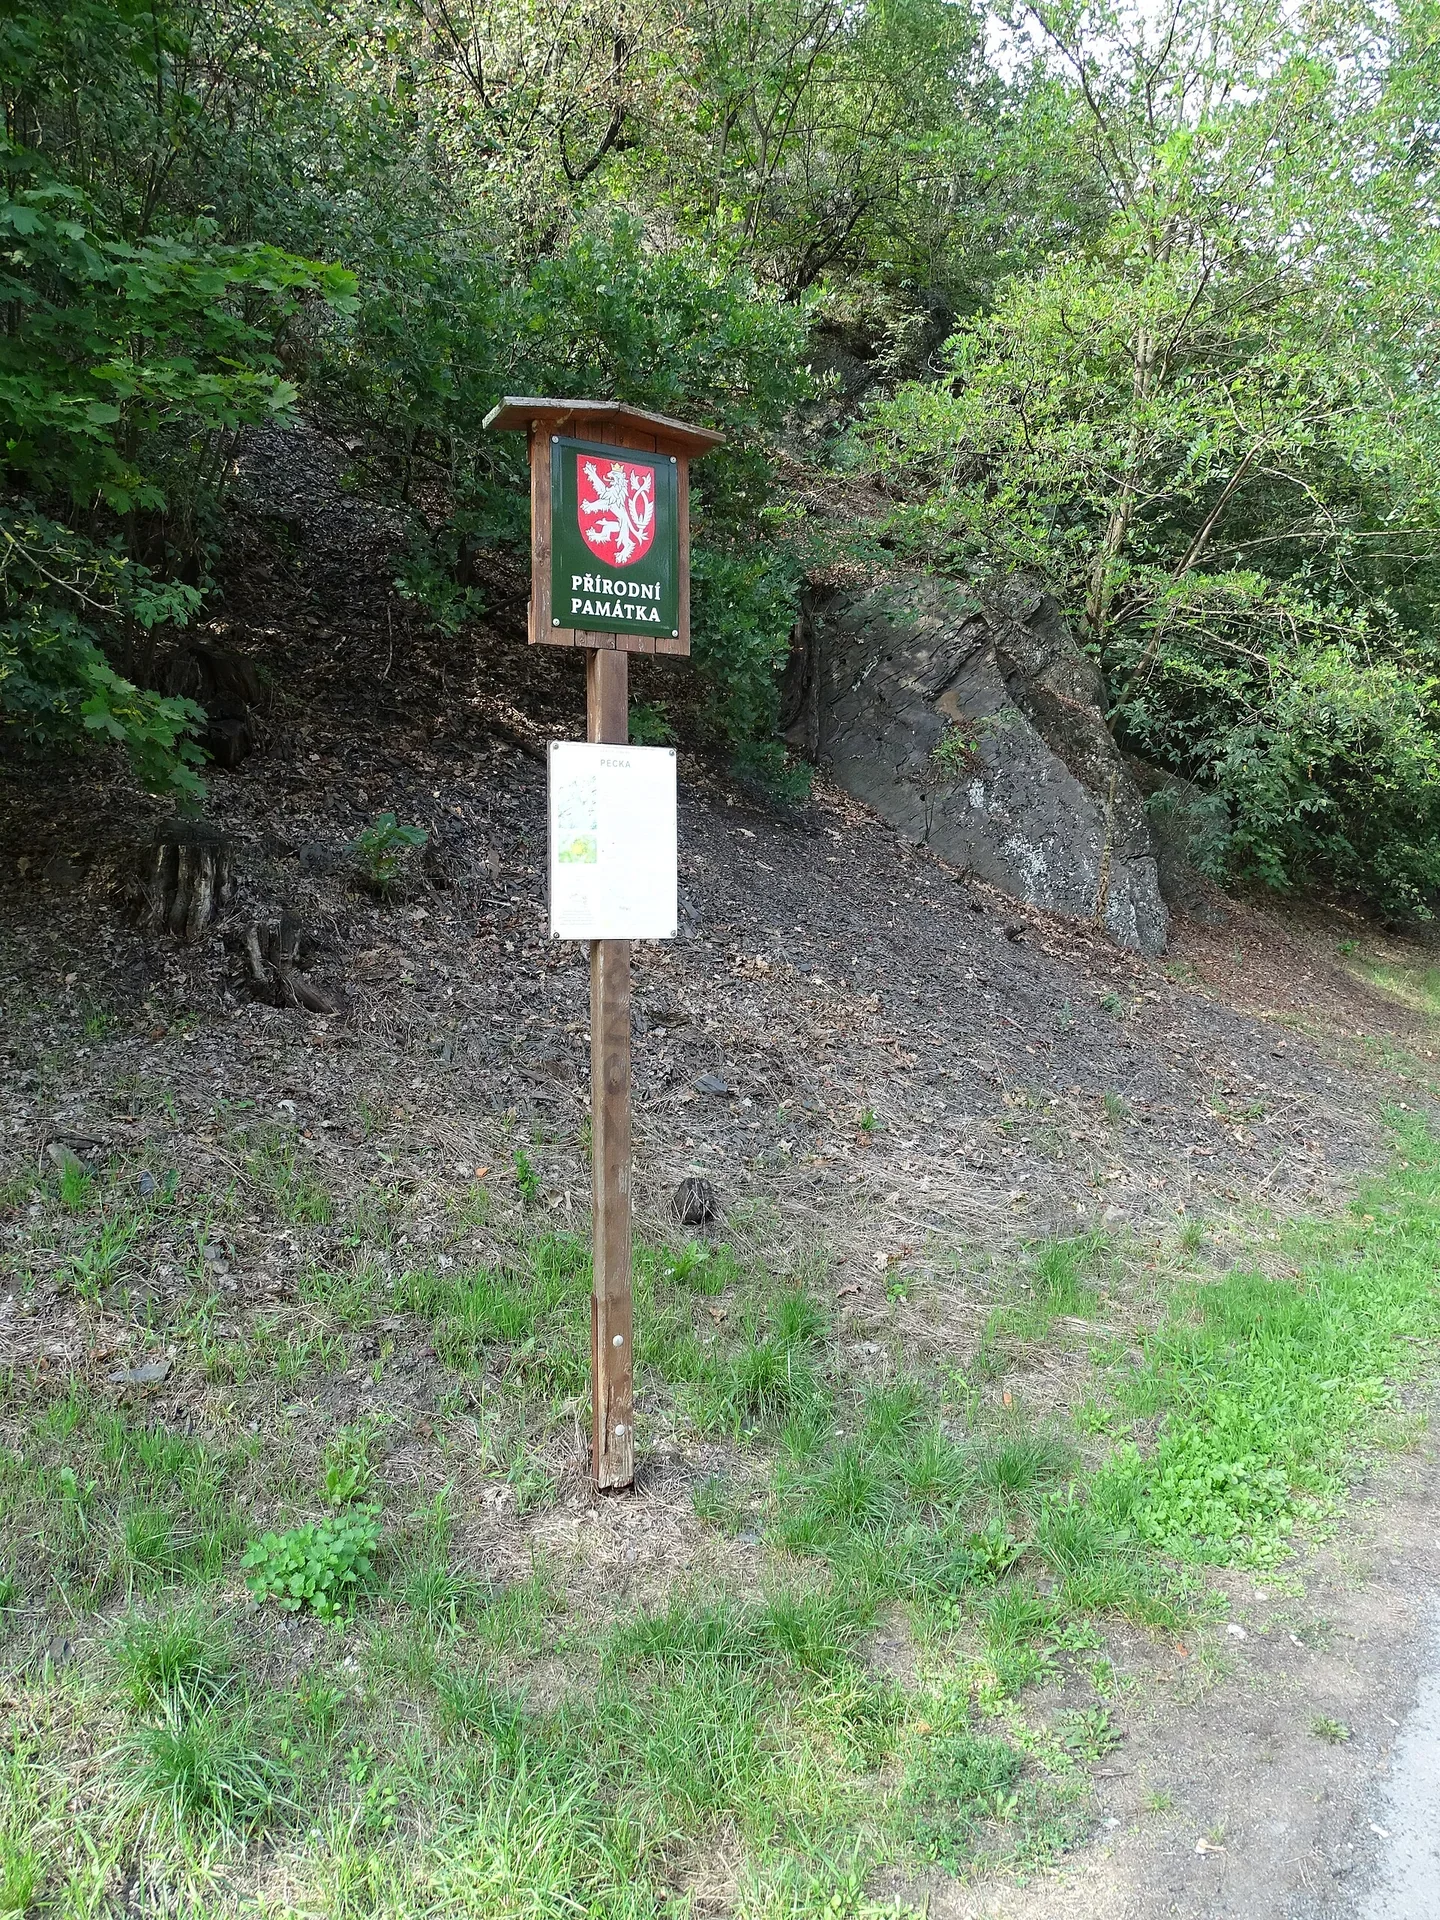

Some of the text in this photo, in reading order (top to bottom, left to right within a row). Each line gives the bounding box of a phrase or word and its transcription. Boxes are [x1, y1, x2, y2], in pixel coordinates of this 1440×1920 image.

[571, 573, 661, 600] PŘÍRODNÍ
[571, 598, 661, 622] PAMÁTKA
[600, 759, 631, 768] PECKA
